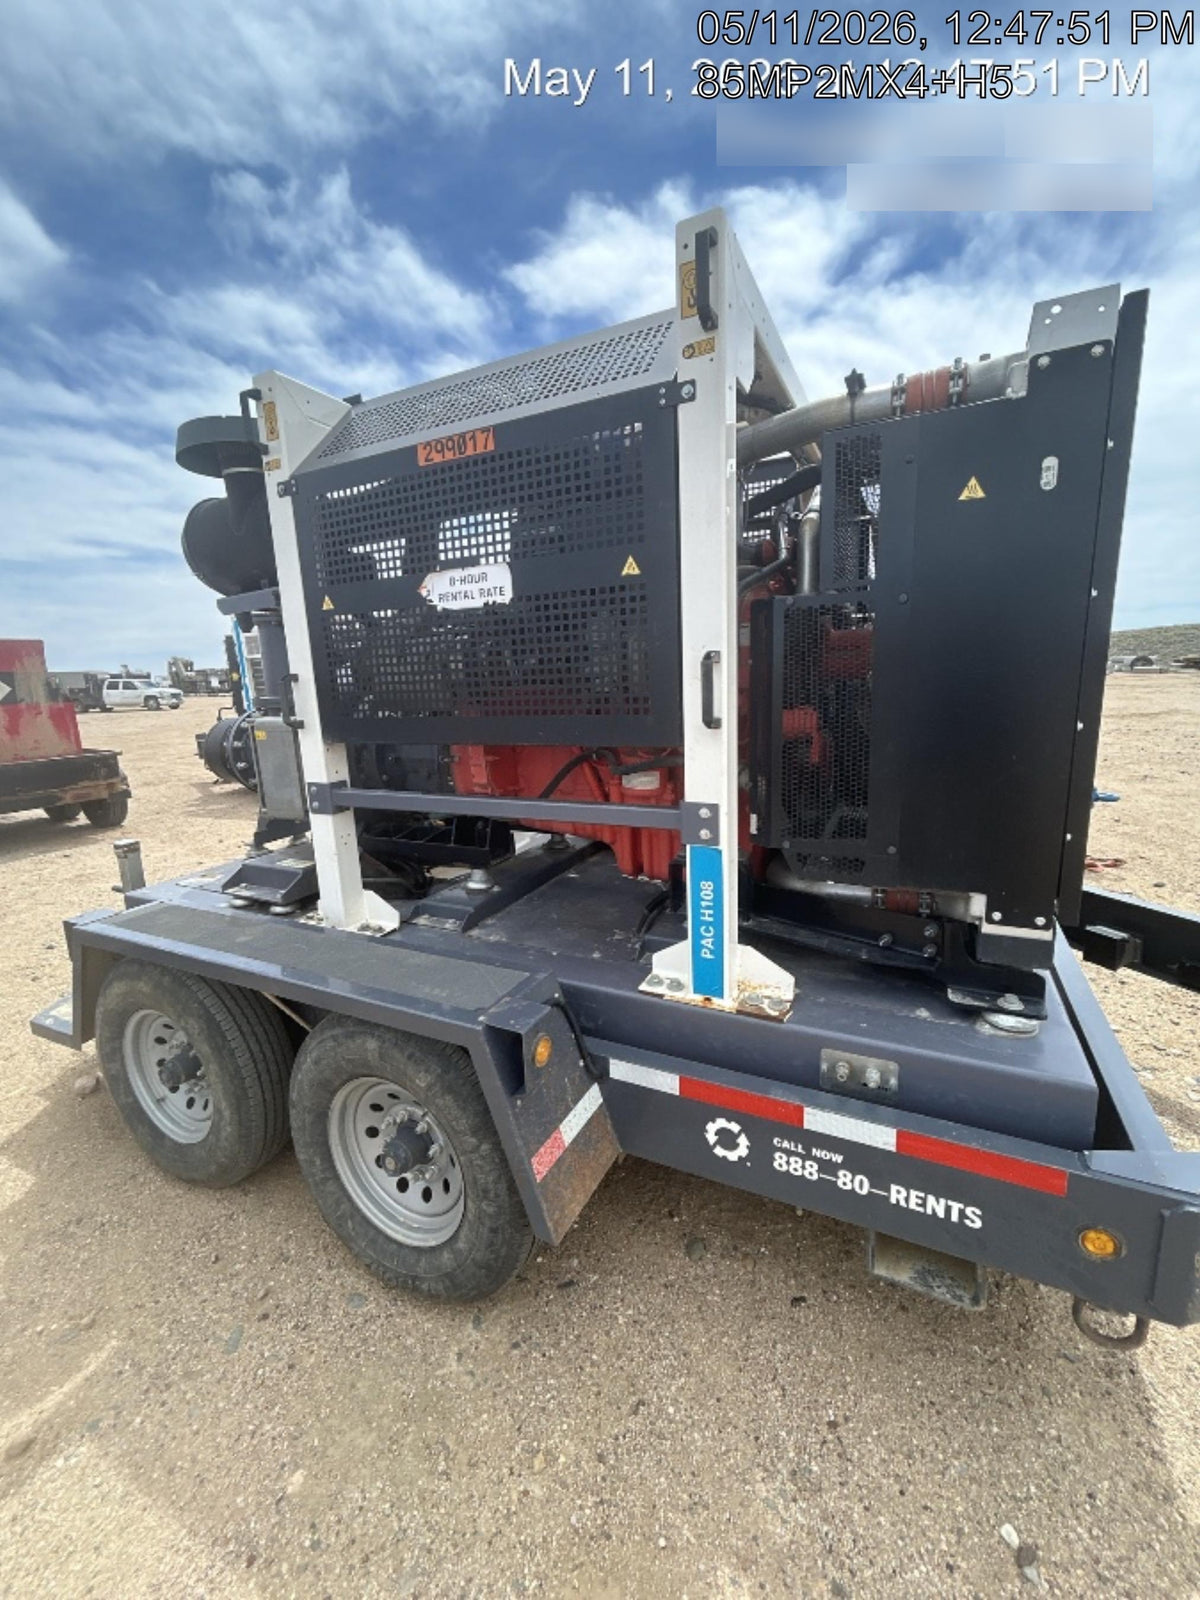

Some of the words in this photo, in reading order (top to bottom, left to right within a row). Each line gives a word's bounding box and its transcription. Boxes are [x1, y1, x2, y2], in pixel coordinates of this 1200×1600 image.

[422, 427, 491, 462] 299017
[438, 590, 475, 603] RENTAL
[479, 586, 505, 598] RATE
[700, 881, 714, 922] H108
[701, 925, 715, 959] PAC
[773, 1137, 806, 1154] CALL
[811, 1147, 844, 1164] NOW
[772, 1151, 983, 1229] 888-80-RENTS
